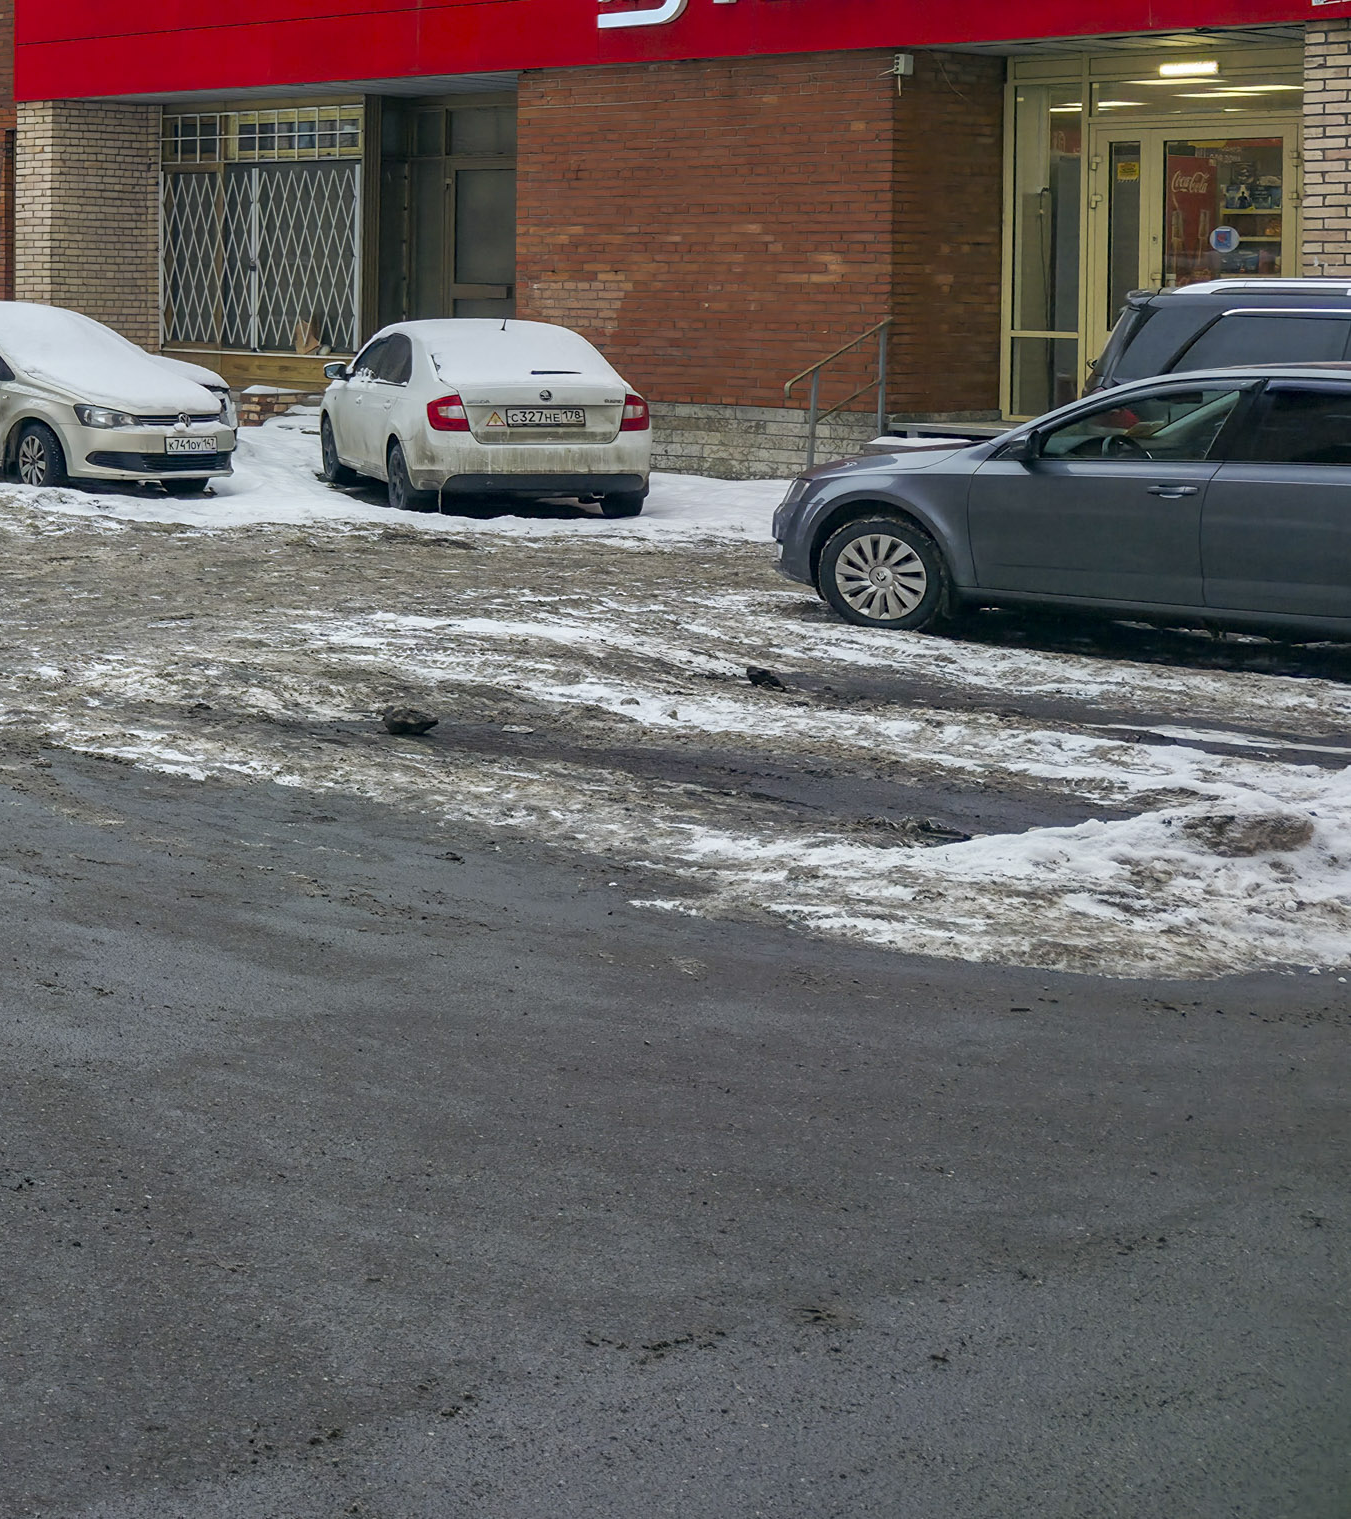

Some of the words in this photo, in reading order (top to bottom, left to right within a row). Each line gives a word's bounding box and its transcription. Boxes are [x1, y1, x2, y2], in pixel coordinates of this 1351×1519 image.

[511, 411, 560, 423] С327НЕ
[562, 410, 581, 420] 178
[169, 439, 201, 450] К741ОУ
